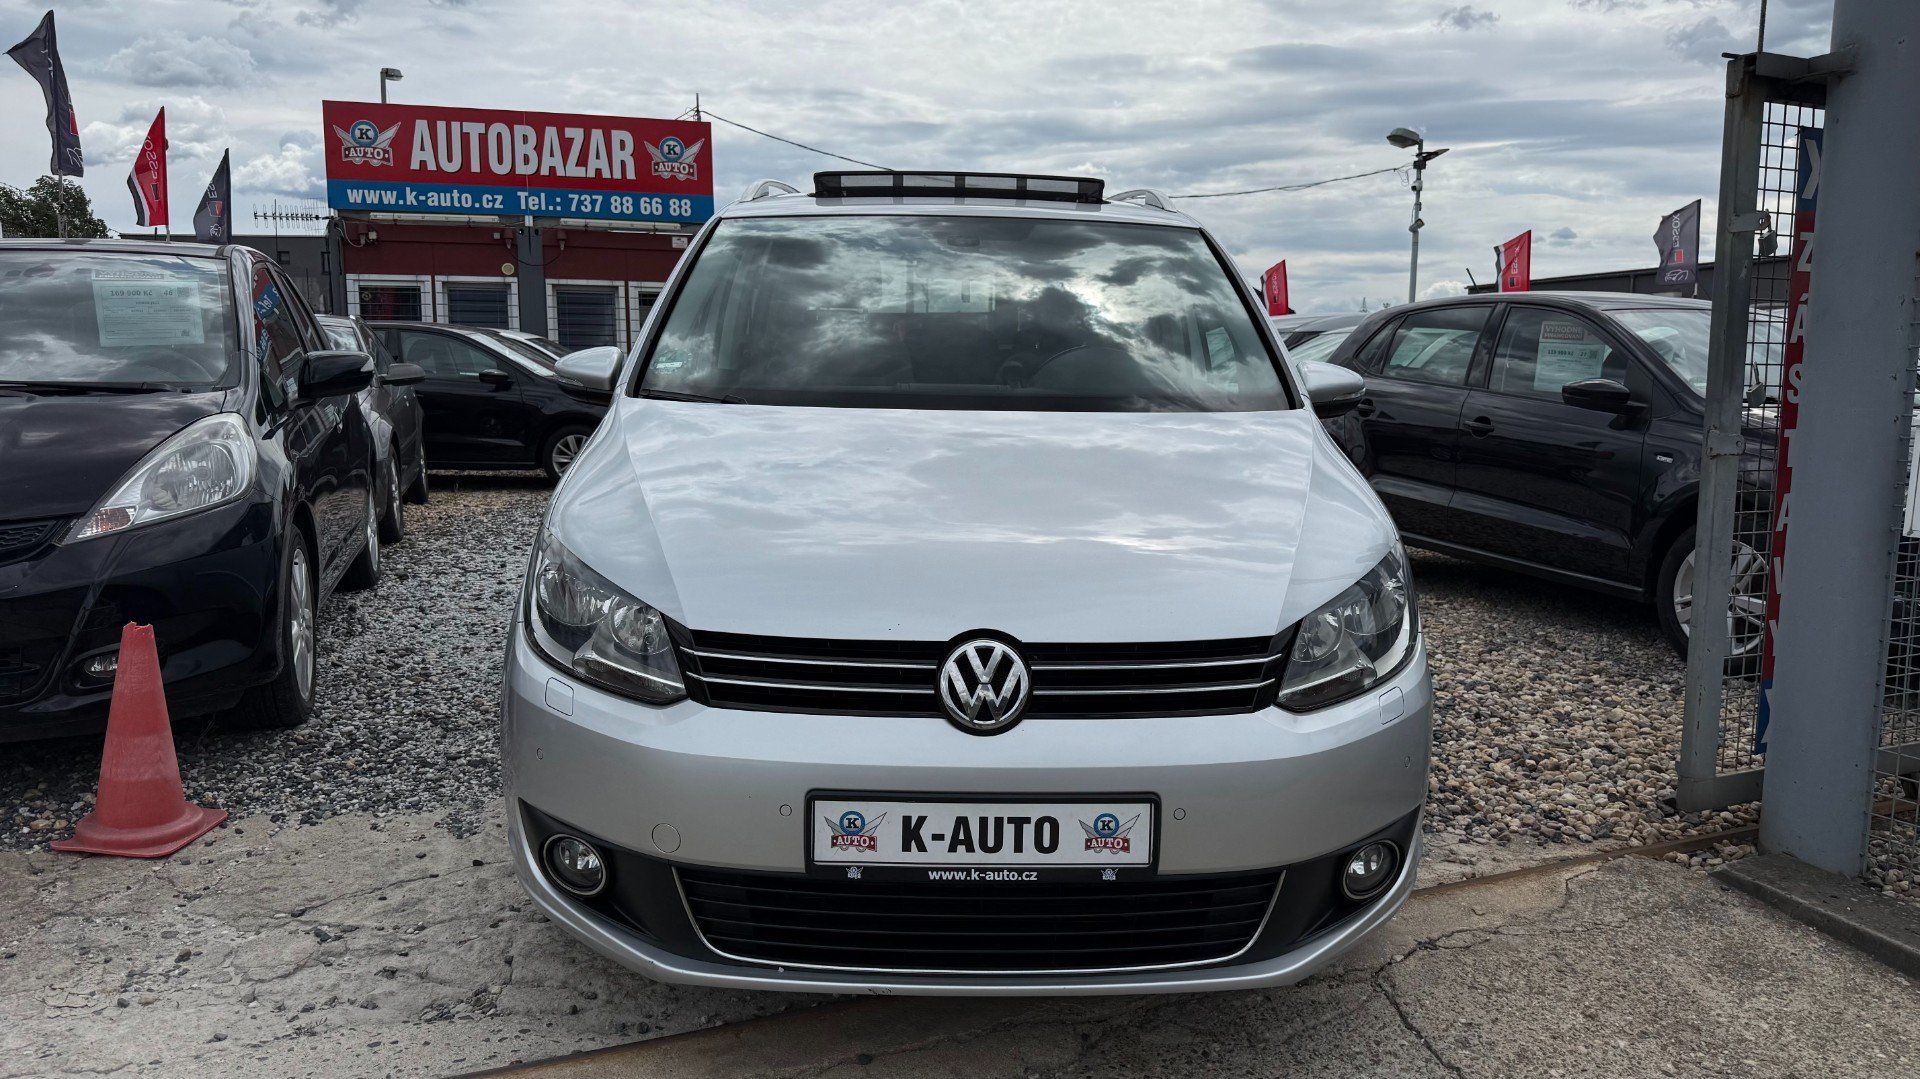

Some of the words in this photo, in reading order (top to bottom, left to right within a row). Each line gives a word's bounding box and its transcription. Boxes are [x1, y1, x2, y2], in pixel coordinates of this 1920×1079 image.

[357, 128, 372, 140] K
[348, 147, 384, 159] AUTO
[410, 119, 637, 180] AUTOBAZAR
[665, 144, 679, 155] K
[657, 162, 689, 174] AUTO
[346, 187, 504, 209] www.k-auto.cz
[517, 191, 561, 211] Tel.:
[568, 194, 603, 213] 737
[610, 195, 633, 215] 88
[640, 197, 663, 215] 66
[669, 199, 692, 217] 88
[845, 817, 860, 829] K
[1099, 819, 1114, 831] K
[901, 815, 1060, 854] K-AUTO
[836, 835, 870, 847] AUTO
[1090, 838, 1124, 849] AUTO
[928, 868, 1038, 881] www.k-auto.cz
